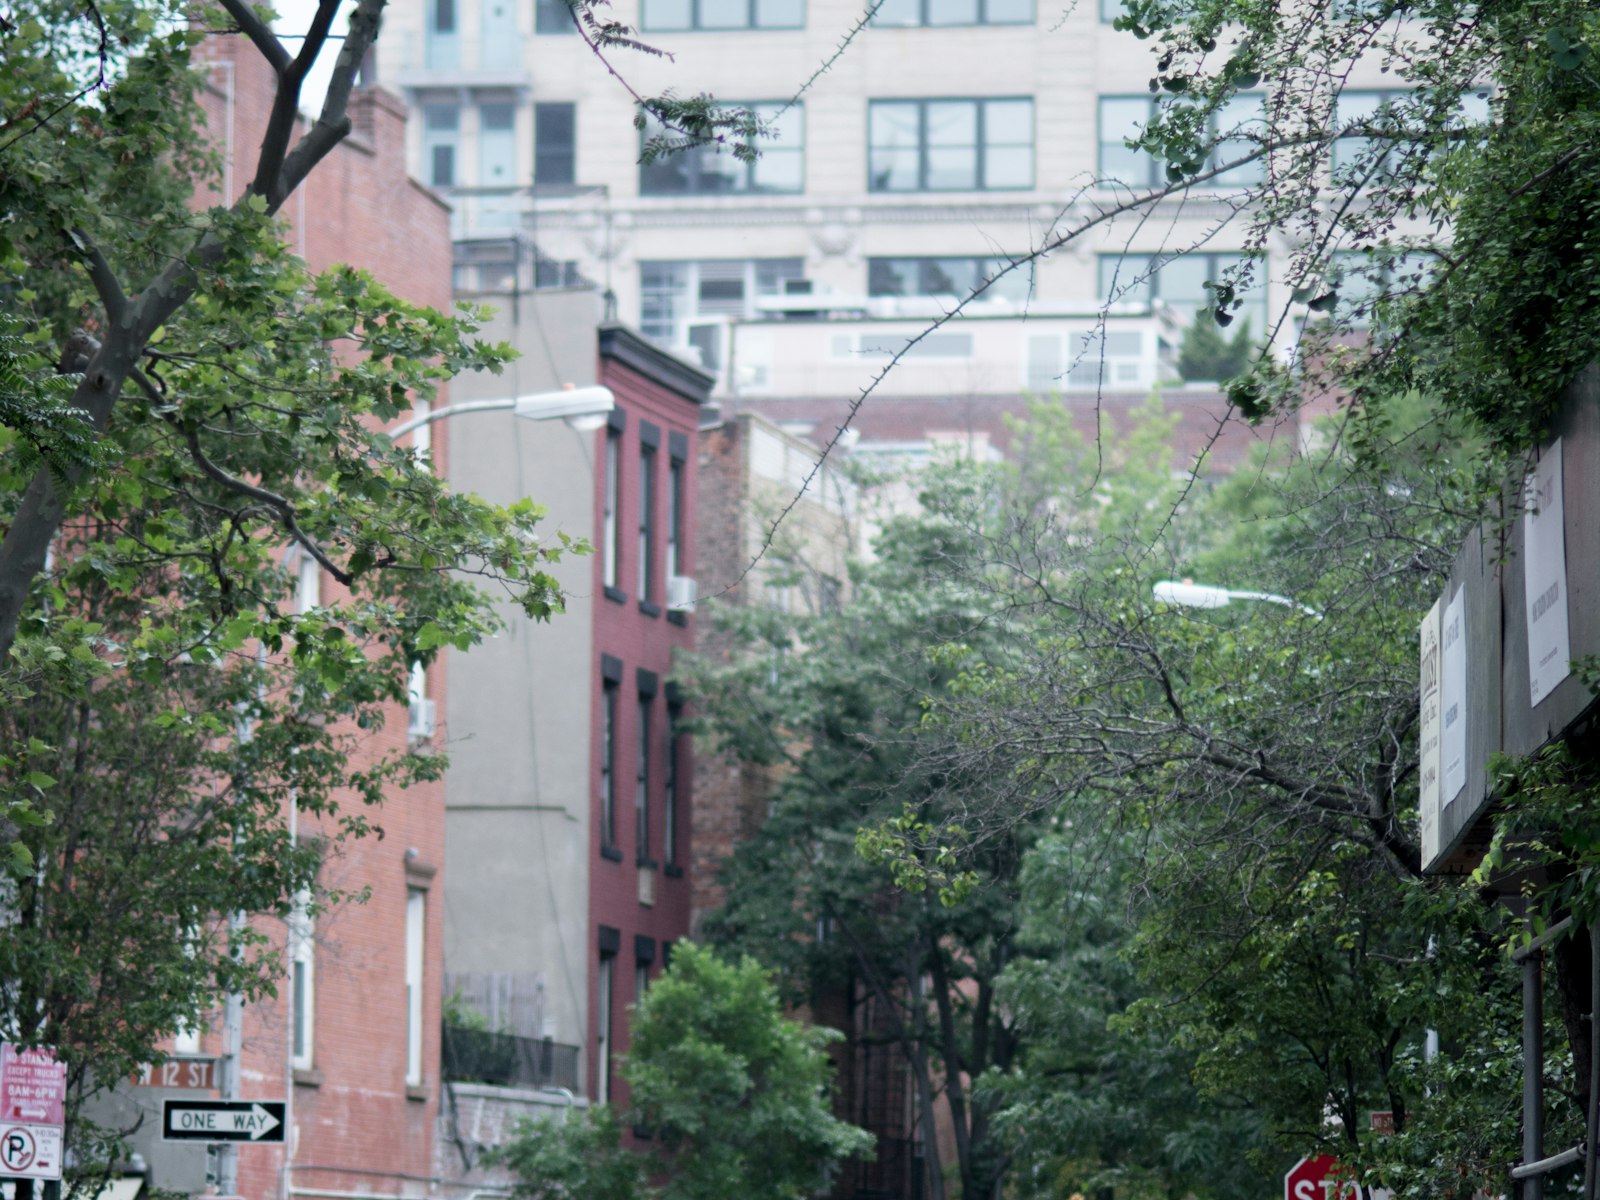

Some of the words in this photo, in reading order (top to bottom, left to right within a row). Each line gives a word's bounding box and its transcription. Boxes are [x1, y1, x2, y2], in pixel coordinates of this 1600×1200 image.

[6, 1052, 17, 1064] NO
[20, 1053, 54, 1067] STANDI
[34, 1068, 59, 1079] TRUCKS
[137, 1061, 153, 1086] W
[162, 1061, 180, 1087] 12
[188, 1062, 209, 1088] ST
[8, 1085, 57, 1099] 8AM-6PM
[181, 1112, 216, 1129] ONE
[233, 1113, 268, 1130] WAY
